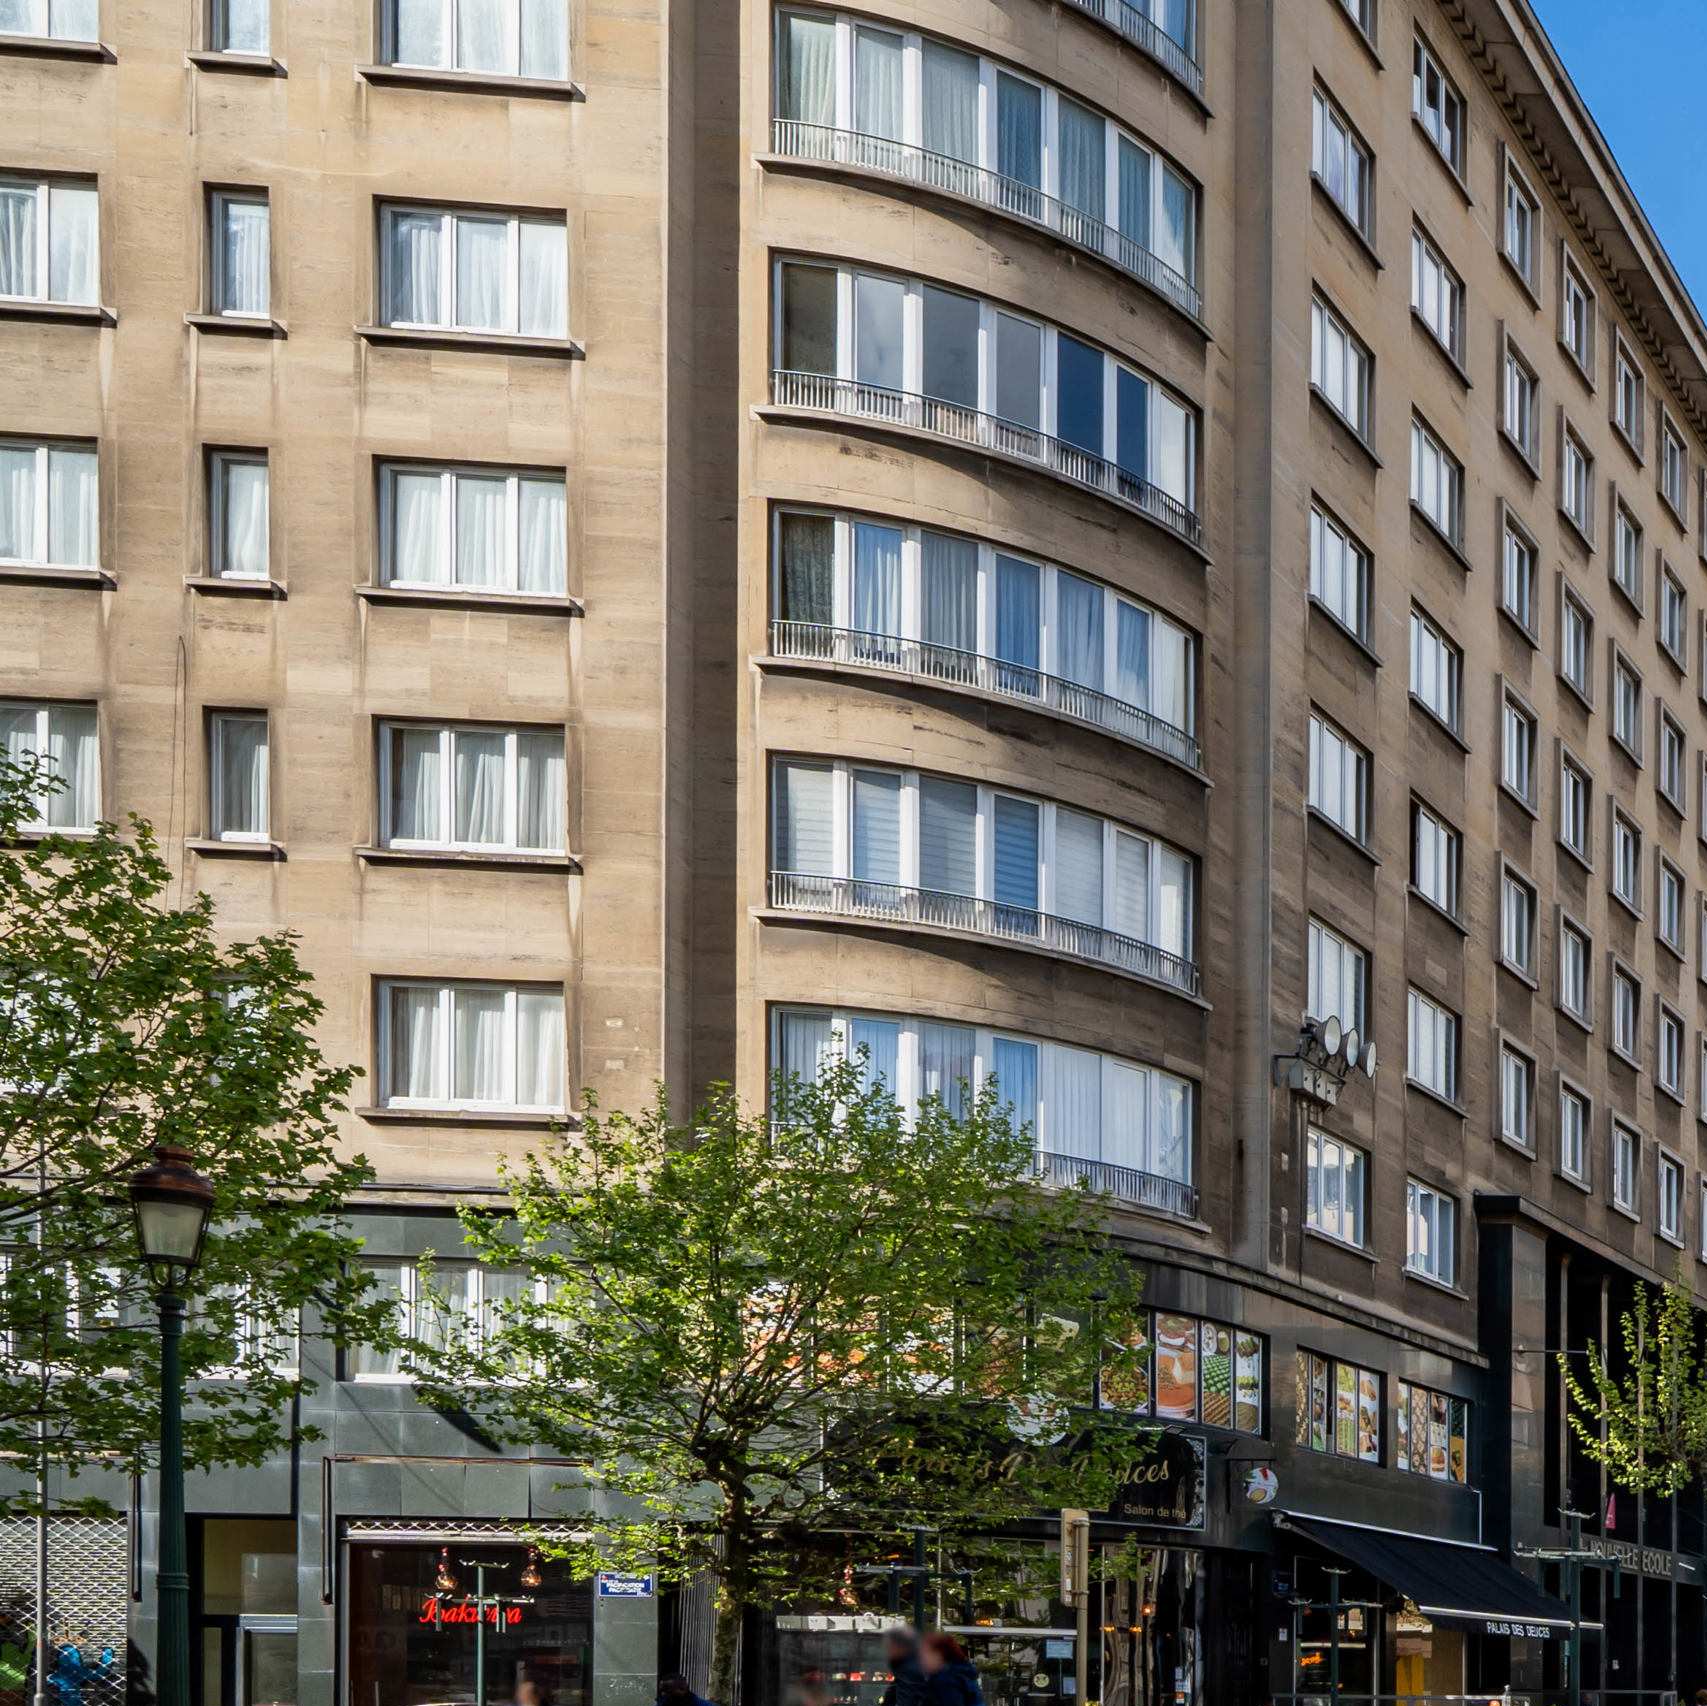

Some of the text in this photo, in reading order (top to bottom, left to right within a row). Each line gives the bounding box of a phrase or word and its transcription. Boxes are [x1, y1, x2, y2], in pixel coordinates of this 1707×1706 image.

[1124, 1503, 1154, 1515] Salon
[1157, 1507, 1169, 1517] de
[1641, 1550, 1672, 1576] ECOLE
[1486, 1621, 1511, 1635] PALAIS
[1511, 1623, 1525, 1637] DES
